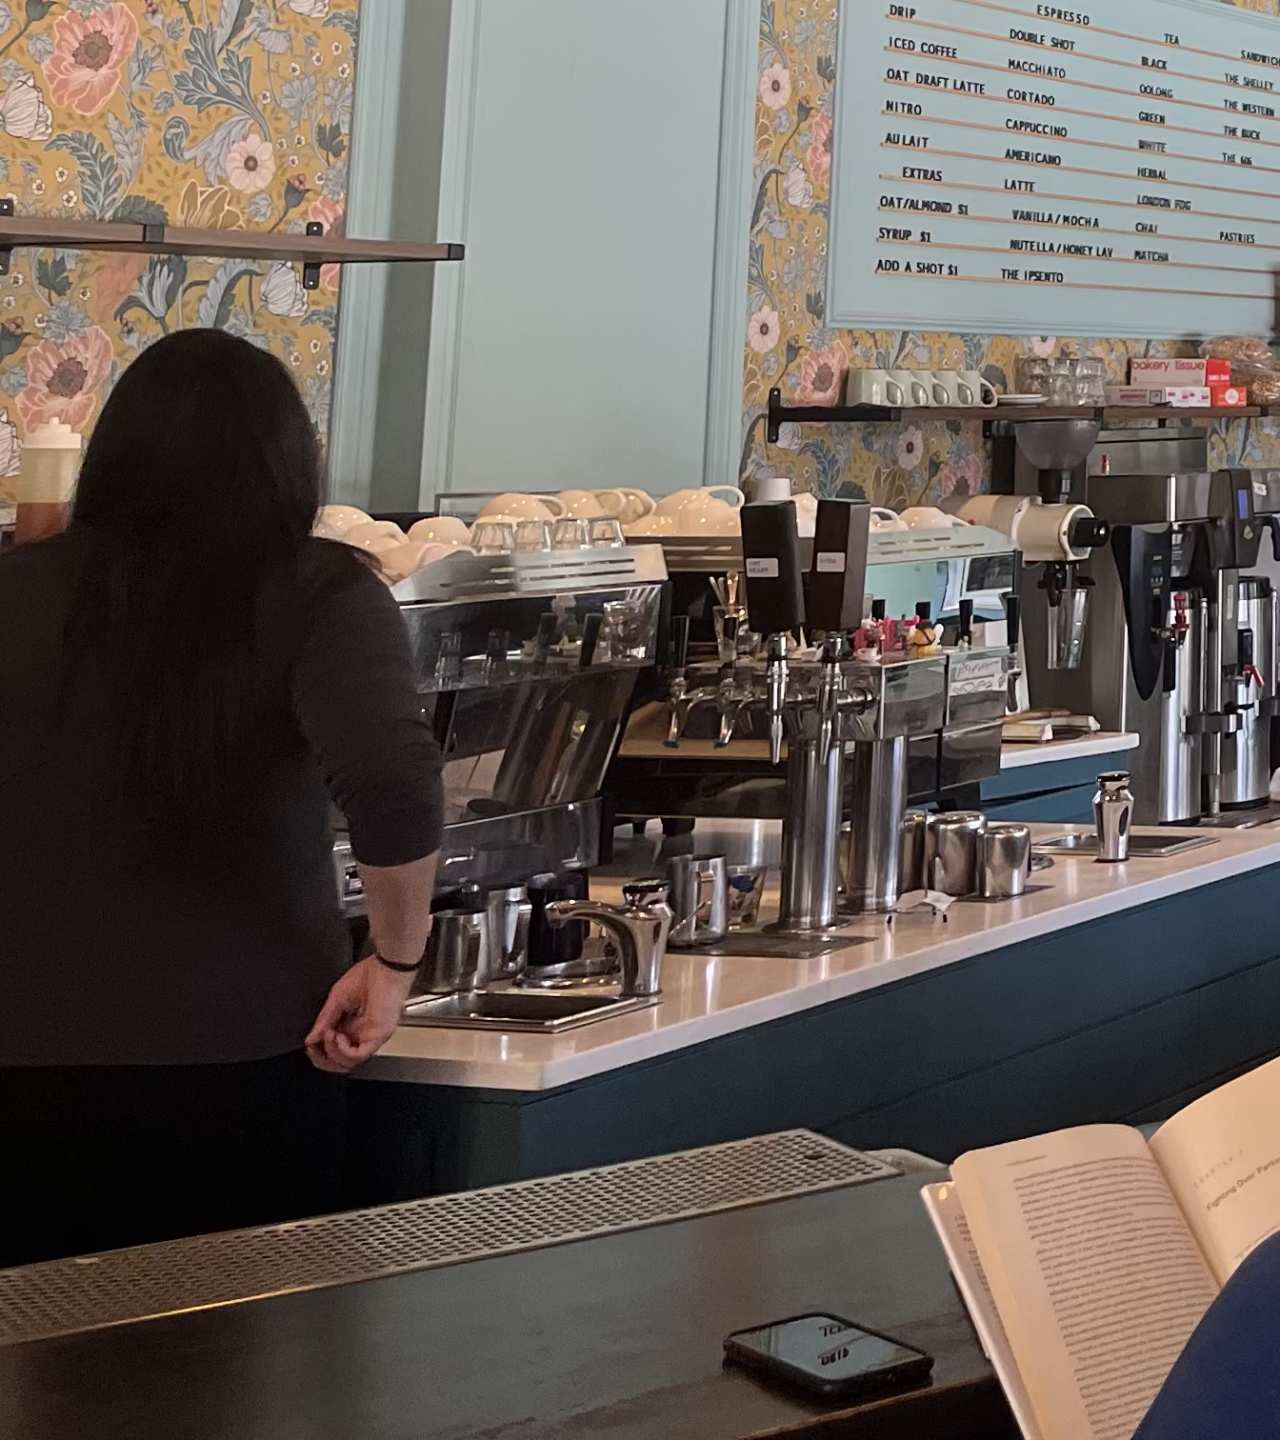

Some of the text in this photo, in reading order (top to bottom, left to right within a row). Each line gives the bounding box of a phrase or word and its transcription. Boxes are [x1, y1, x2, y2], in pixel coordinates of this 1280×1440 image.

[890, 5, 916, 18] DRIP
[1038, 5, 1090, 25] ESPRESSO
[1010, 29, 1075, 50] DOUBLE SHOT
[1165, 34, 1180, 44] TEA
[890, 37, 957, 58] ICED COFFEE
[1009, 59, 1066, 78] MACCHIATO
[1142, 57, 1167, 70] BLACK
[887, 69, 985, 94] OAT DRAFT LATTE
[1226, 74, 1240, 84] THE
[1008, 89, 1055, 105] CORTADO
[1140, 85, 1173, 98] OOLONG
[887, 101, 922, 115] NITRO
[1224, 100, 1275, 116] THE WESTERN
[1139, 112, 1166, 124] GREEN
[1006, 119, 1068, 137] CAPPUCCINO
[1225, 126, 1238, 136] THE
[886, 133, 929, 147] AU LAIT
[1005, 149, 1062, 165] AMERICANO
[1223, 153, 1236, 163] THE
[903, 167, 943, 181] EXTRAS
[1138, 168, 1167, 180] HERBAL
[1005, 180, 1035, 192] LATTE
[880, 196, 969, 215] OAT/ALMOND $1
[1137, 196, 1171, 208] LONDON
[1136, 223, 1158, 233] CHAI
[879, 228, 931, 242] SYRUP $1
[1220, 232, 1255, 243] PASTRIES
[1135, 251, 1169, 261] MATCHA
[877, 260, 958, 275] ADD A SHOT $1
[1002, 269, 1064, 282] THE IPSENTO
